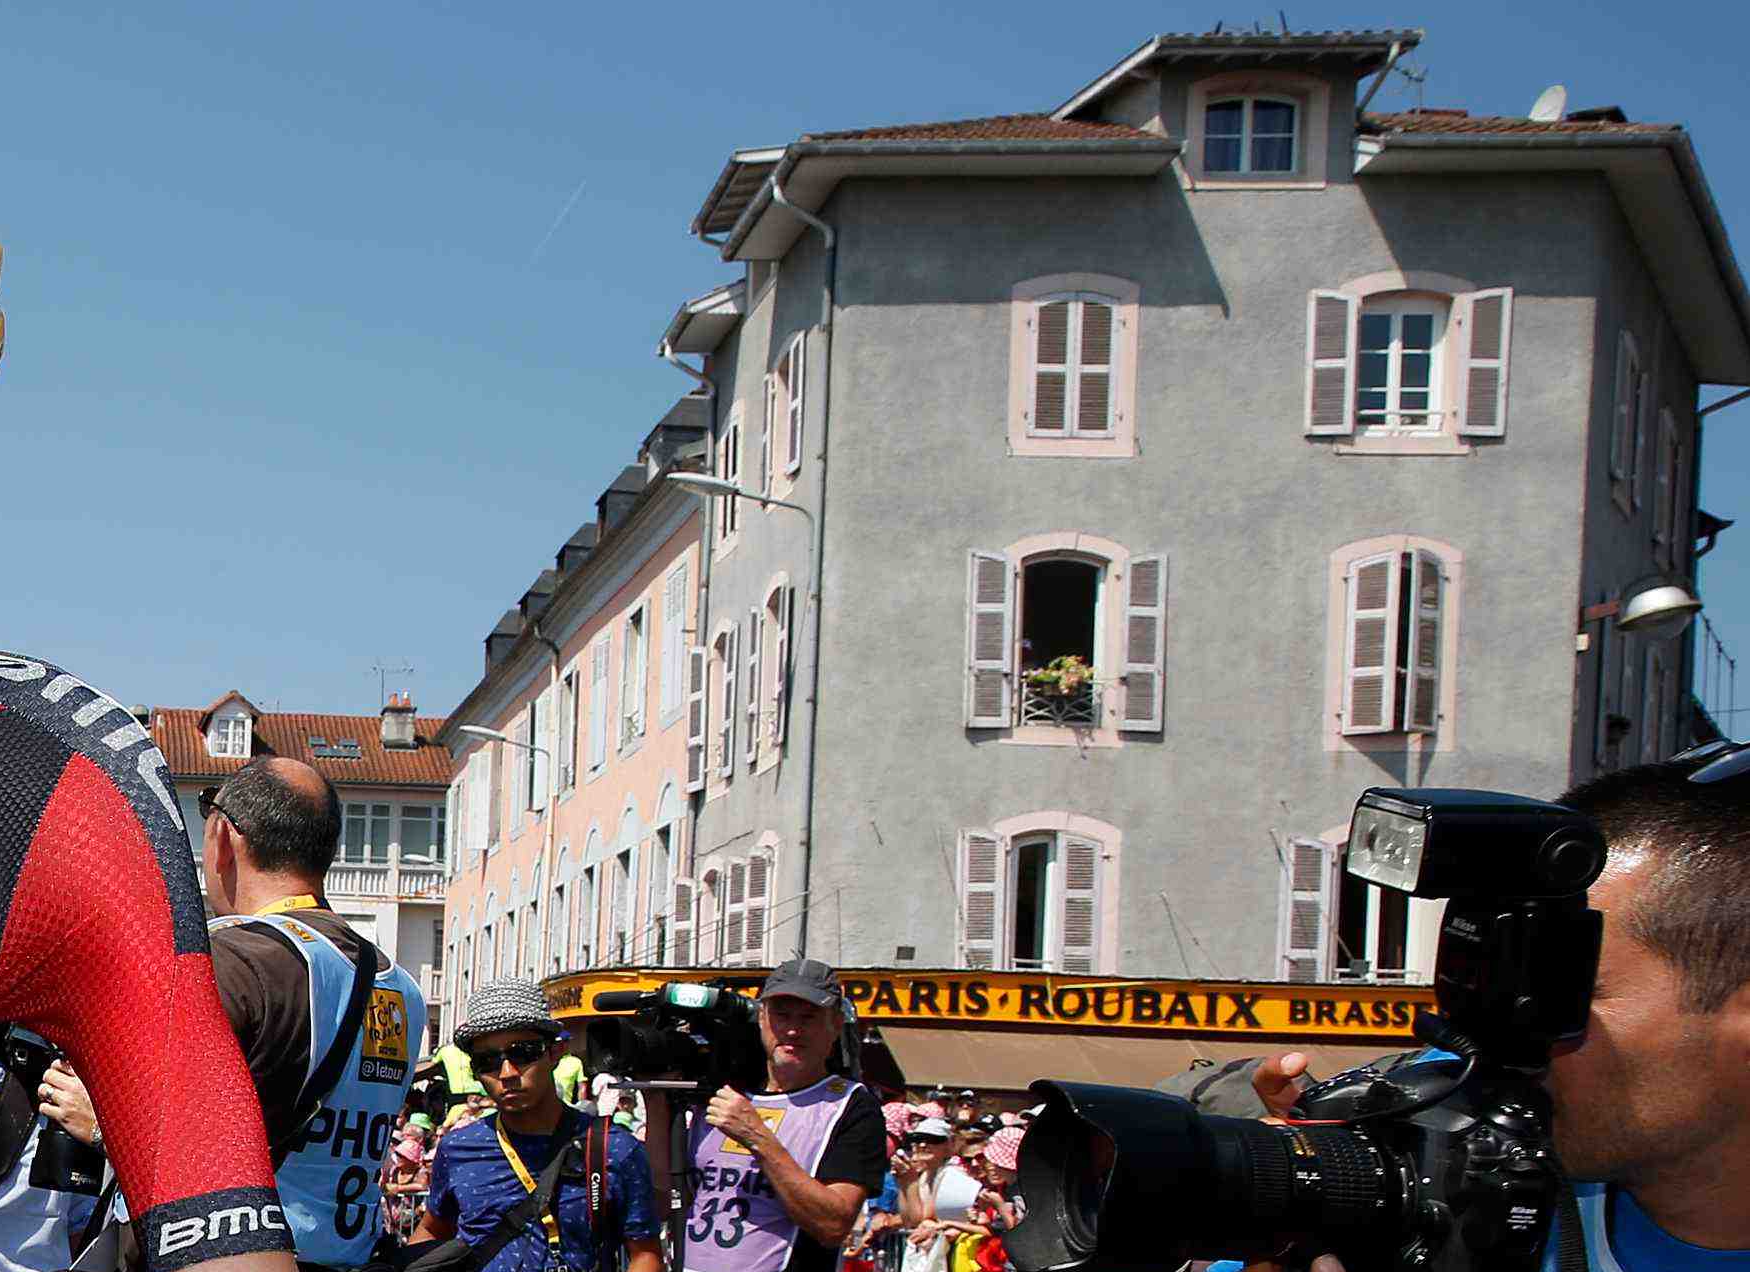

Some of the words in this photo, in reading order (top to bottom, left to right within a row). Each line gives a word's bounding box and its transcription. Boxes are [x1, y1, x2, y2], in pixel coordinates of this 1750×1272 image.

[846, 978, 990, 1018] PARIS
[1019, 982, 1263, 1029] ROUBAIX
[591, 1172, 601, 1210] Canon
[158, 1201, 286, 1257] BMC
[689, 1198, 749, 1249] 33
